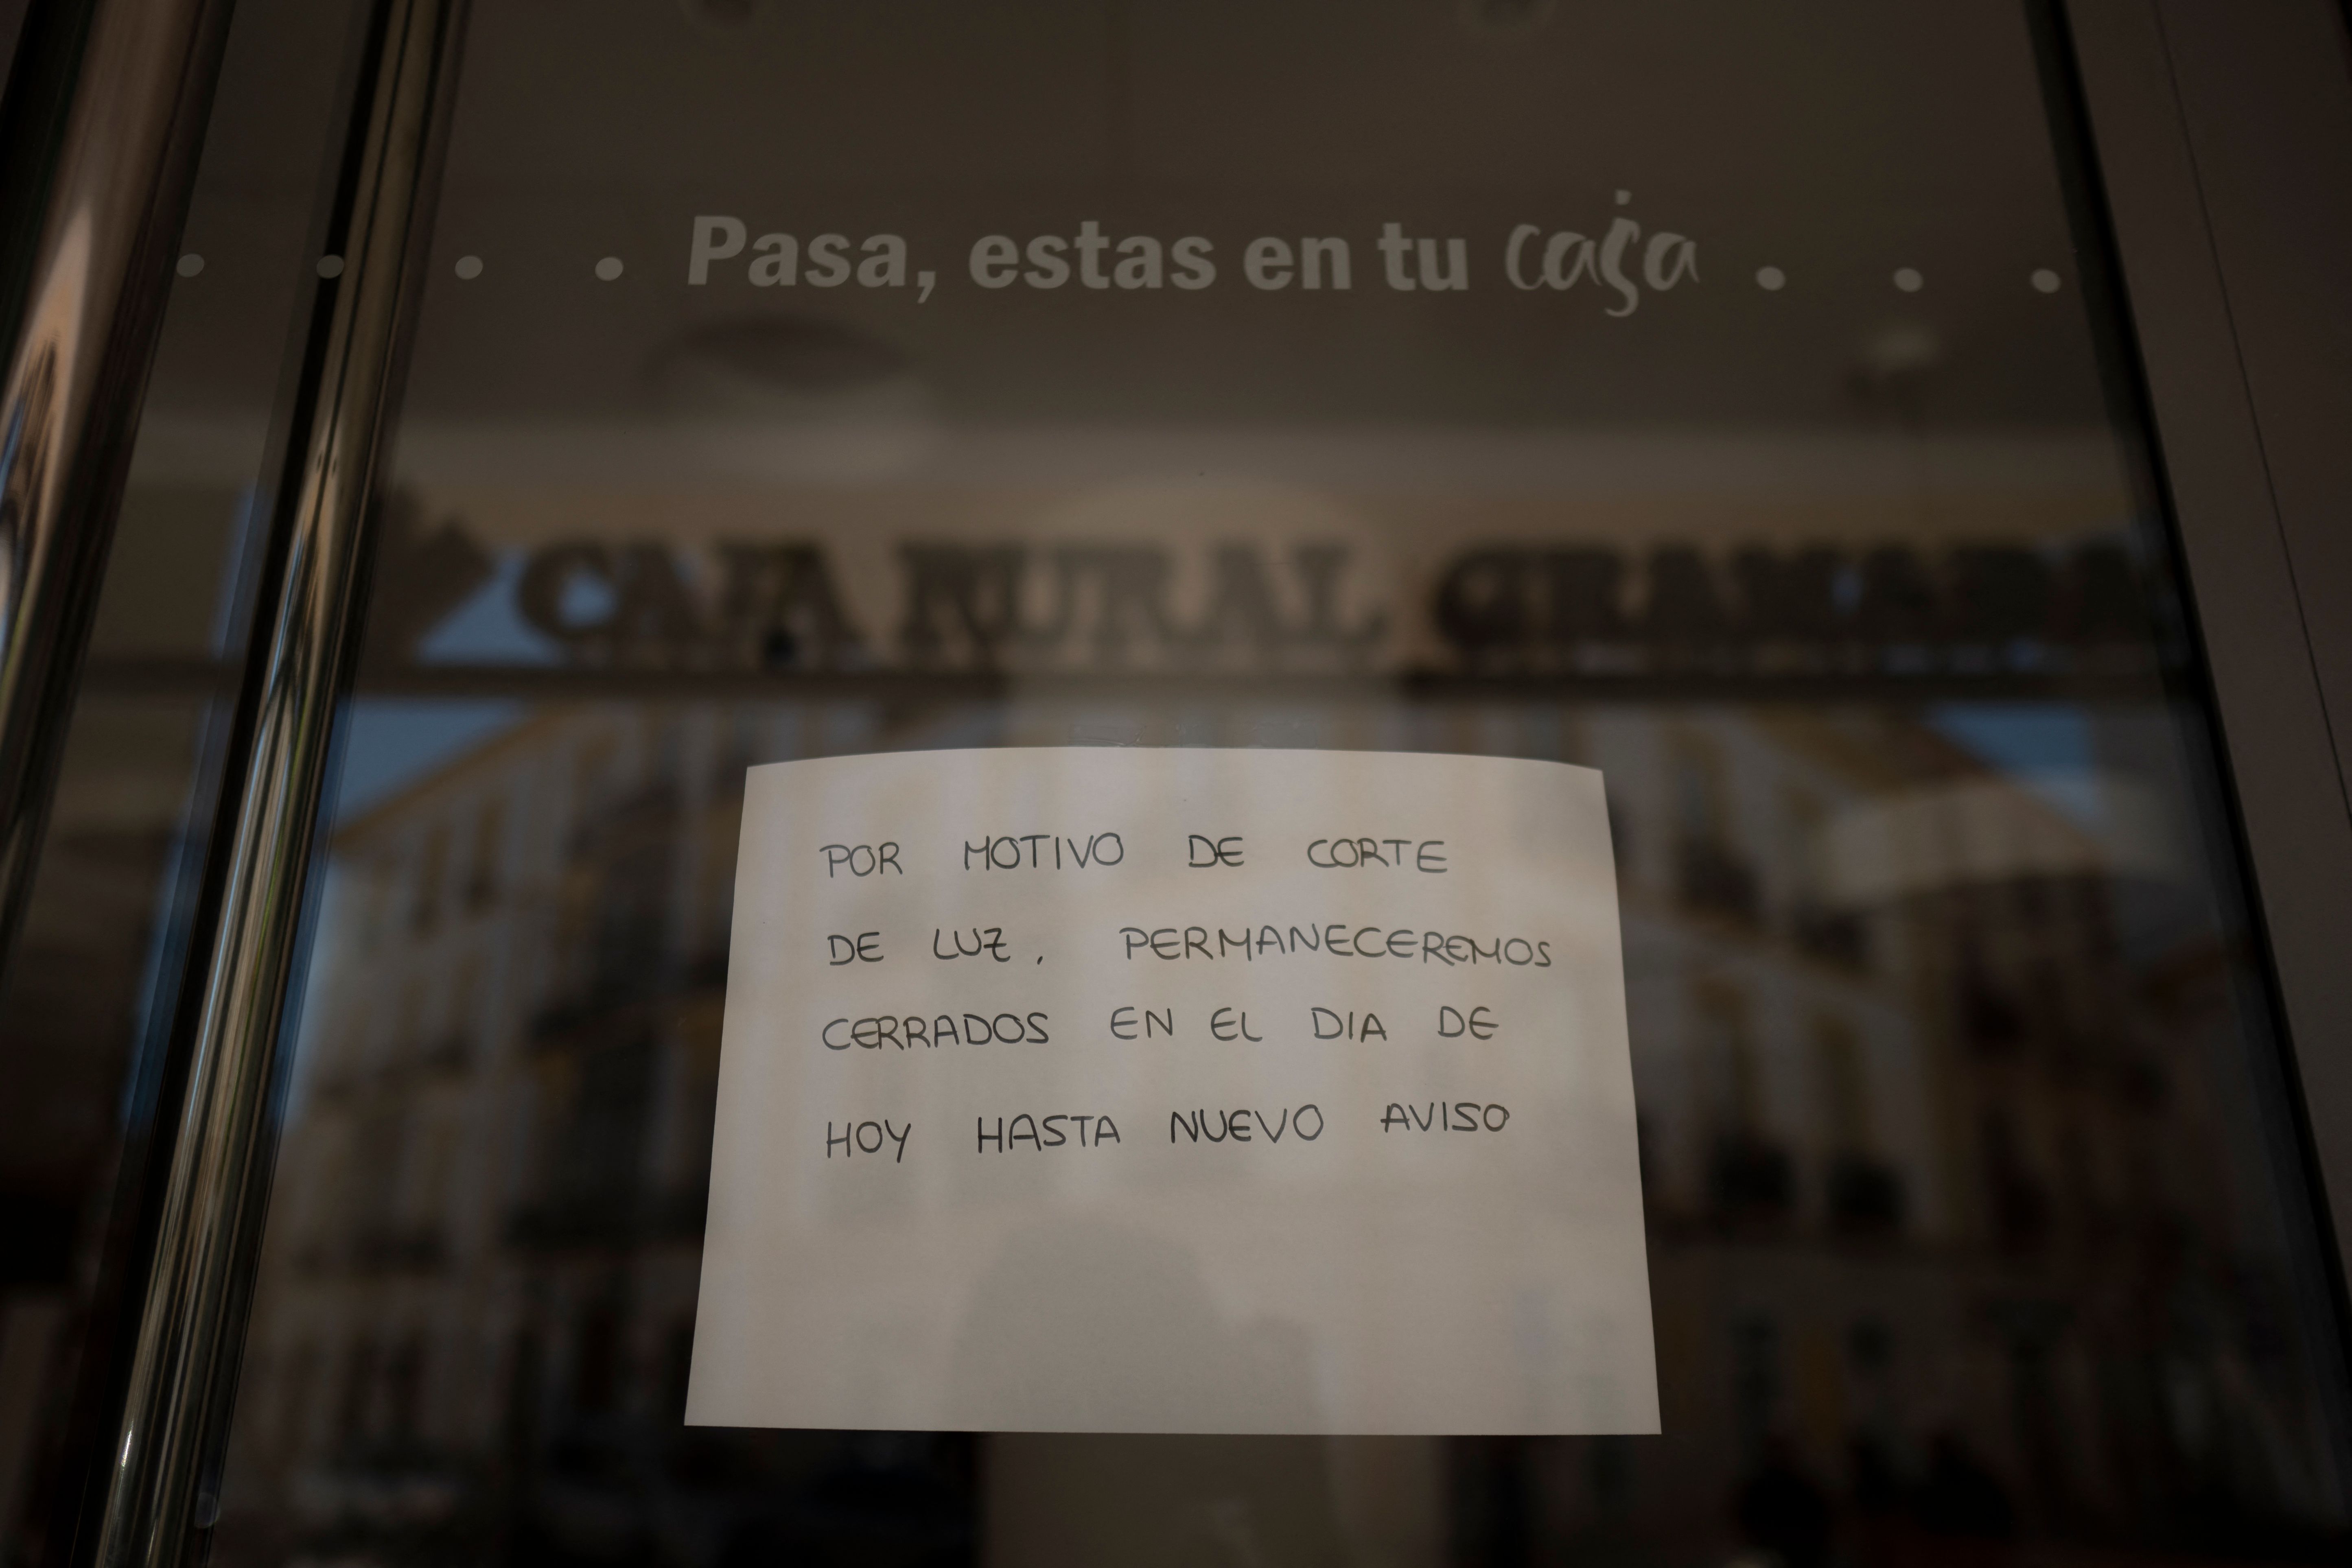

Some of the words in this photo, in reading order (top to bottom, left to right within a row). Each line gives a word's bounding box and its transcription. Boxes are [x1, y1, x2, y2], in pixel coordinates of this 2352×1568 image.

[687, 214, 936, 304] Pasa,
[968, 220, 1217, 291] estas
[1243, 236, 1352, 291] en
[1377, 222, 1469, 292] tu
[819, 841, 903, 878] POR
[964, 832, 1125, 871] MOTIVO
[1188, 834, 1245, 868] DE
[1306, 837, 1448, 874] CORTE
[827, 931, 884, 966] DE
[1119, 923, 1552, 968] PERMANECEREMOS
[822, 1011, 1050, 1051] CERRADOS
[1110, 1006, 1173, 1040] EN
[1210, 1006, 1263, 1043] EL
[1311, 1006, 1387, 1043] DIA
[1437, 1005, 1499, 1041] DE
[826, 1119, 912, 1164] HOY
[977, 1113, 1121, 1154] HASTA
[1170, 1104, 1324, 1144] NUEVO
[1380, 1101, 1510, 1133] AVISO
